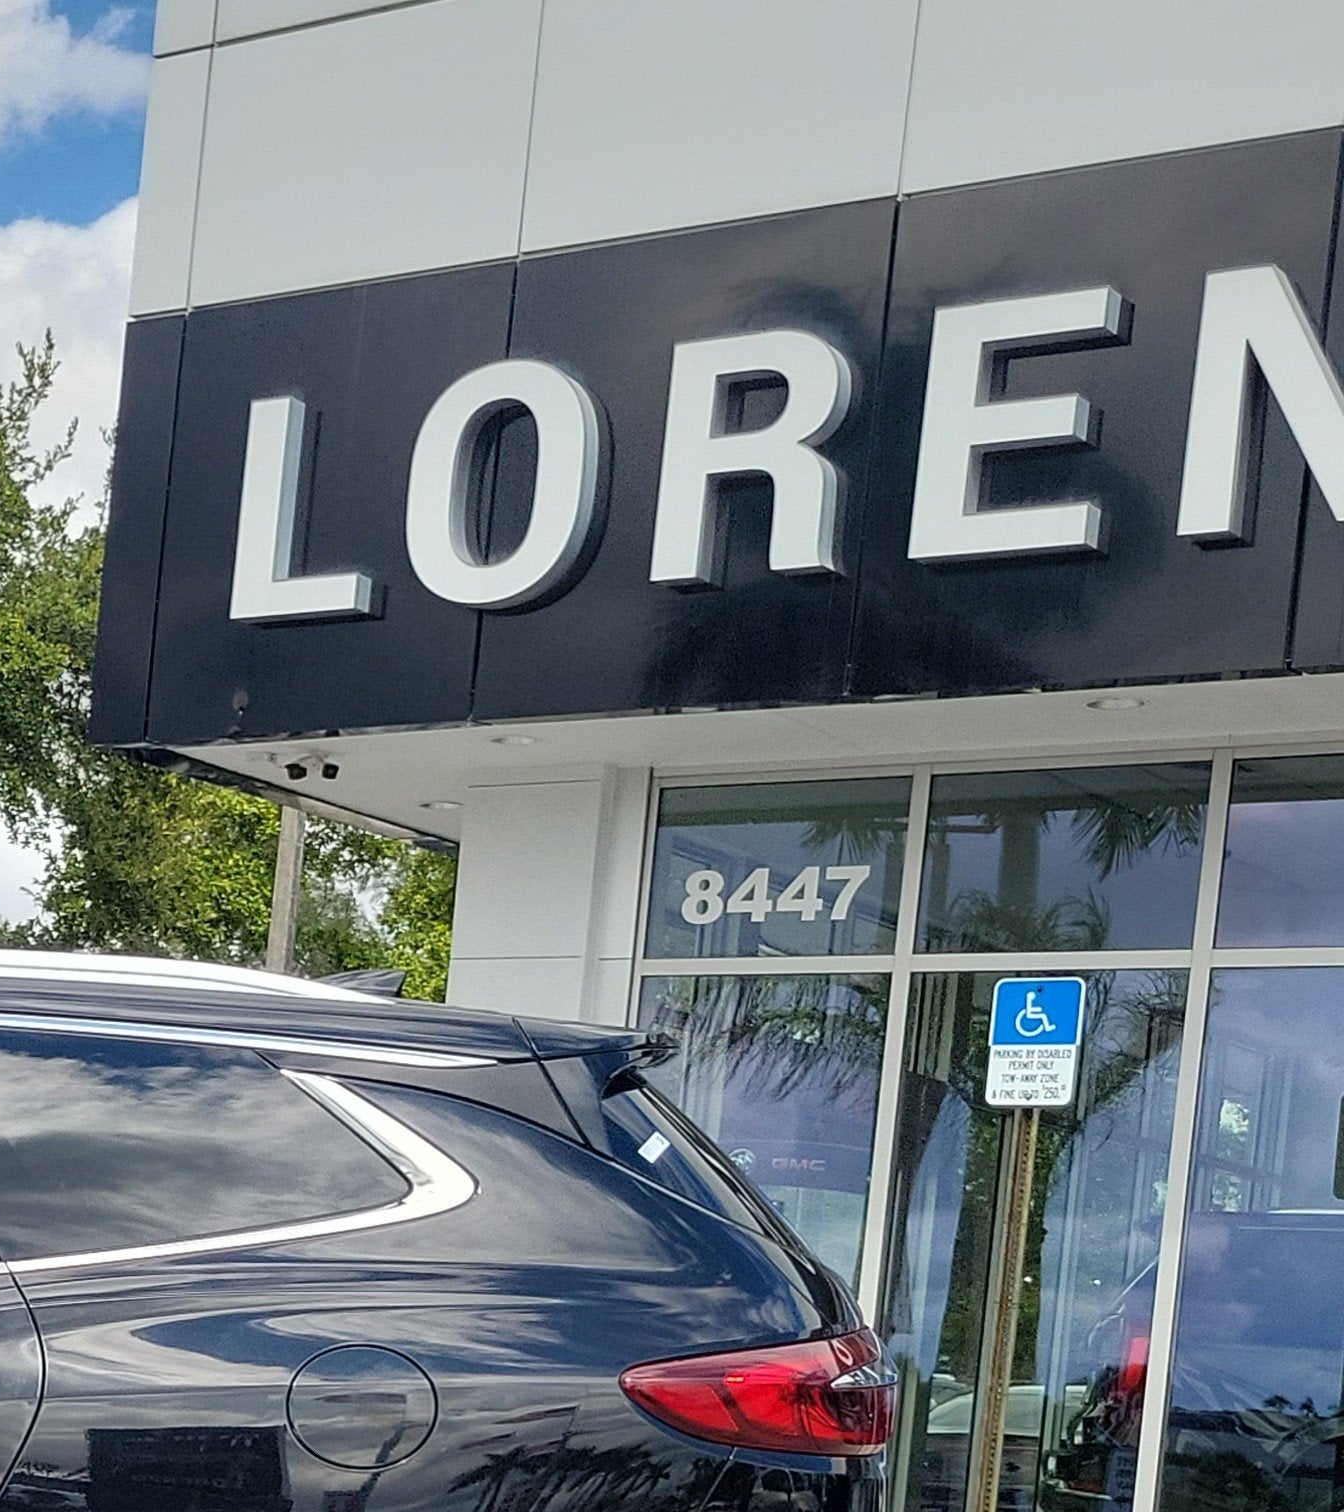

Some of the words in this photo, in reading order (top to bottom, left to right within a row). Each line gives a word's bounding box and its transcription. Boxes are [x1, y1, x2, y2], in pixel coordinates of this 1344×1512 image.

[229, 262, 1344, 625] LOREN
[681, 865, 871, 925] 8447
[993, 1049, 1023, 1059] PARKING
[1025, 1049, 1036, 1059] BY
[1037, 1049, 1072, 1059] DISABLED
[1008, 1060, 1034, 1070] PERMIT
[1036, 1060, 1055, 1070] ONLY
[1001, 1073, 1038, 1083] TOW-AWAY
[1040, 1073, 1060, 1083] ZONE
[999, 1089, 1016, 1099] FINE
[771, 1157, 828, 1172] GMC
